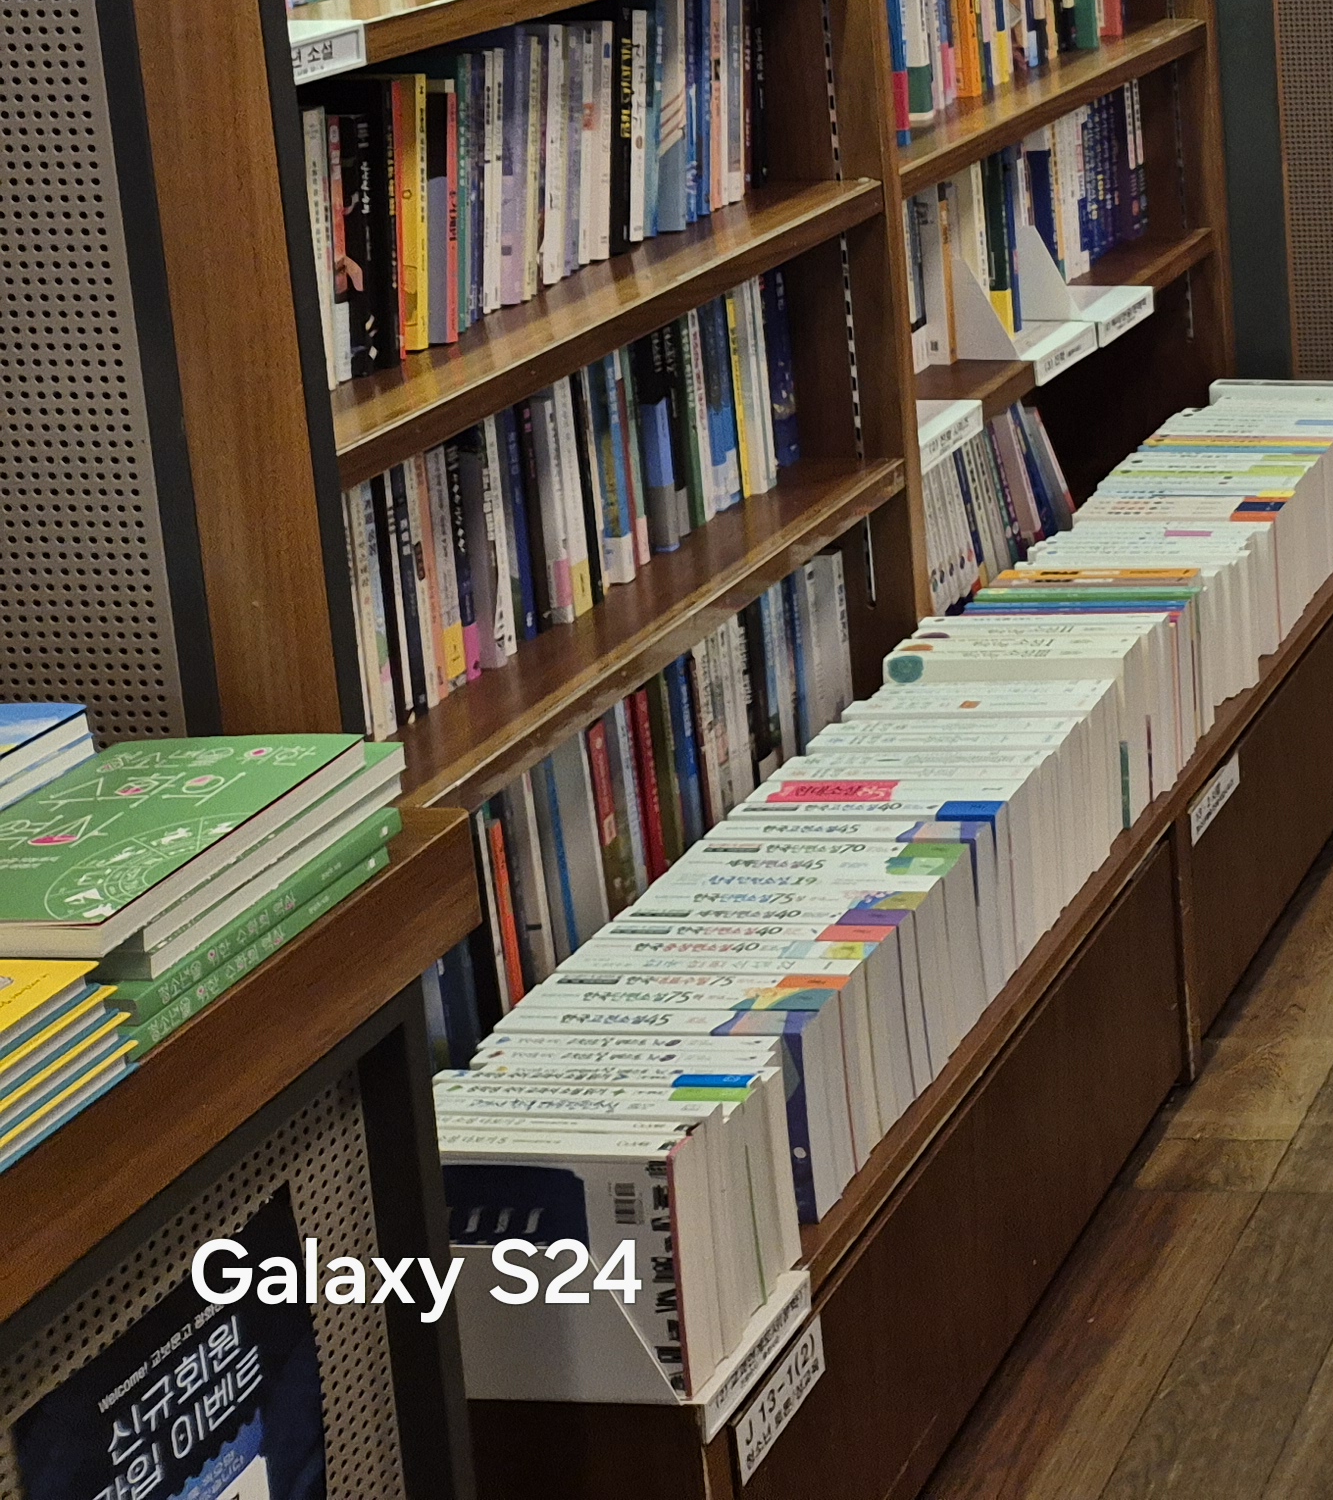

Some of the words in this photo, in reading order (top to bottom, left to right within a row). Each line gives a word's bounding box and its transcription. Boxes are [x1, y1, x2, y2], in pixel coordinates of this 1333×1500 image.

[308, 40, 333, 63] 소설
[39, 771, 246, 811] 수학의
[96, 747, 234, 773] 청소년을
[98, 1362, 148, 1413] Welcome!
[151, 1323, 193, 1368] 교보문고
[108, 1315, 242, 1466] 신규회원
[171, 1345, 263, 1459] 이벤트
